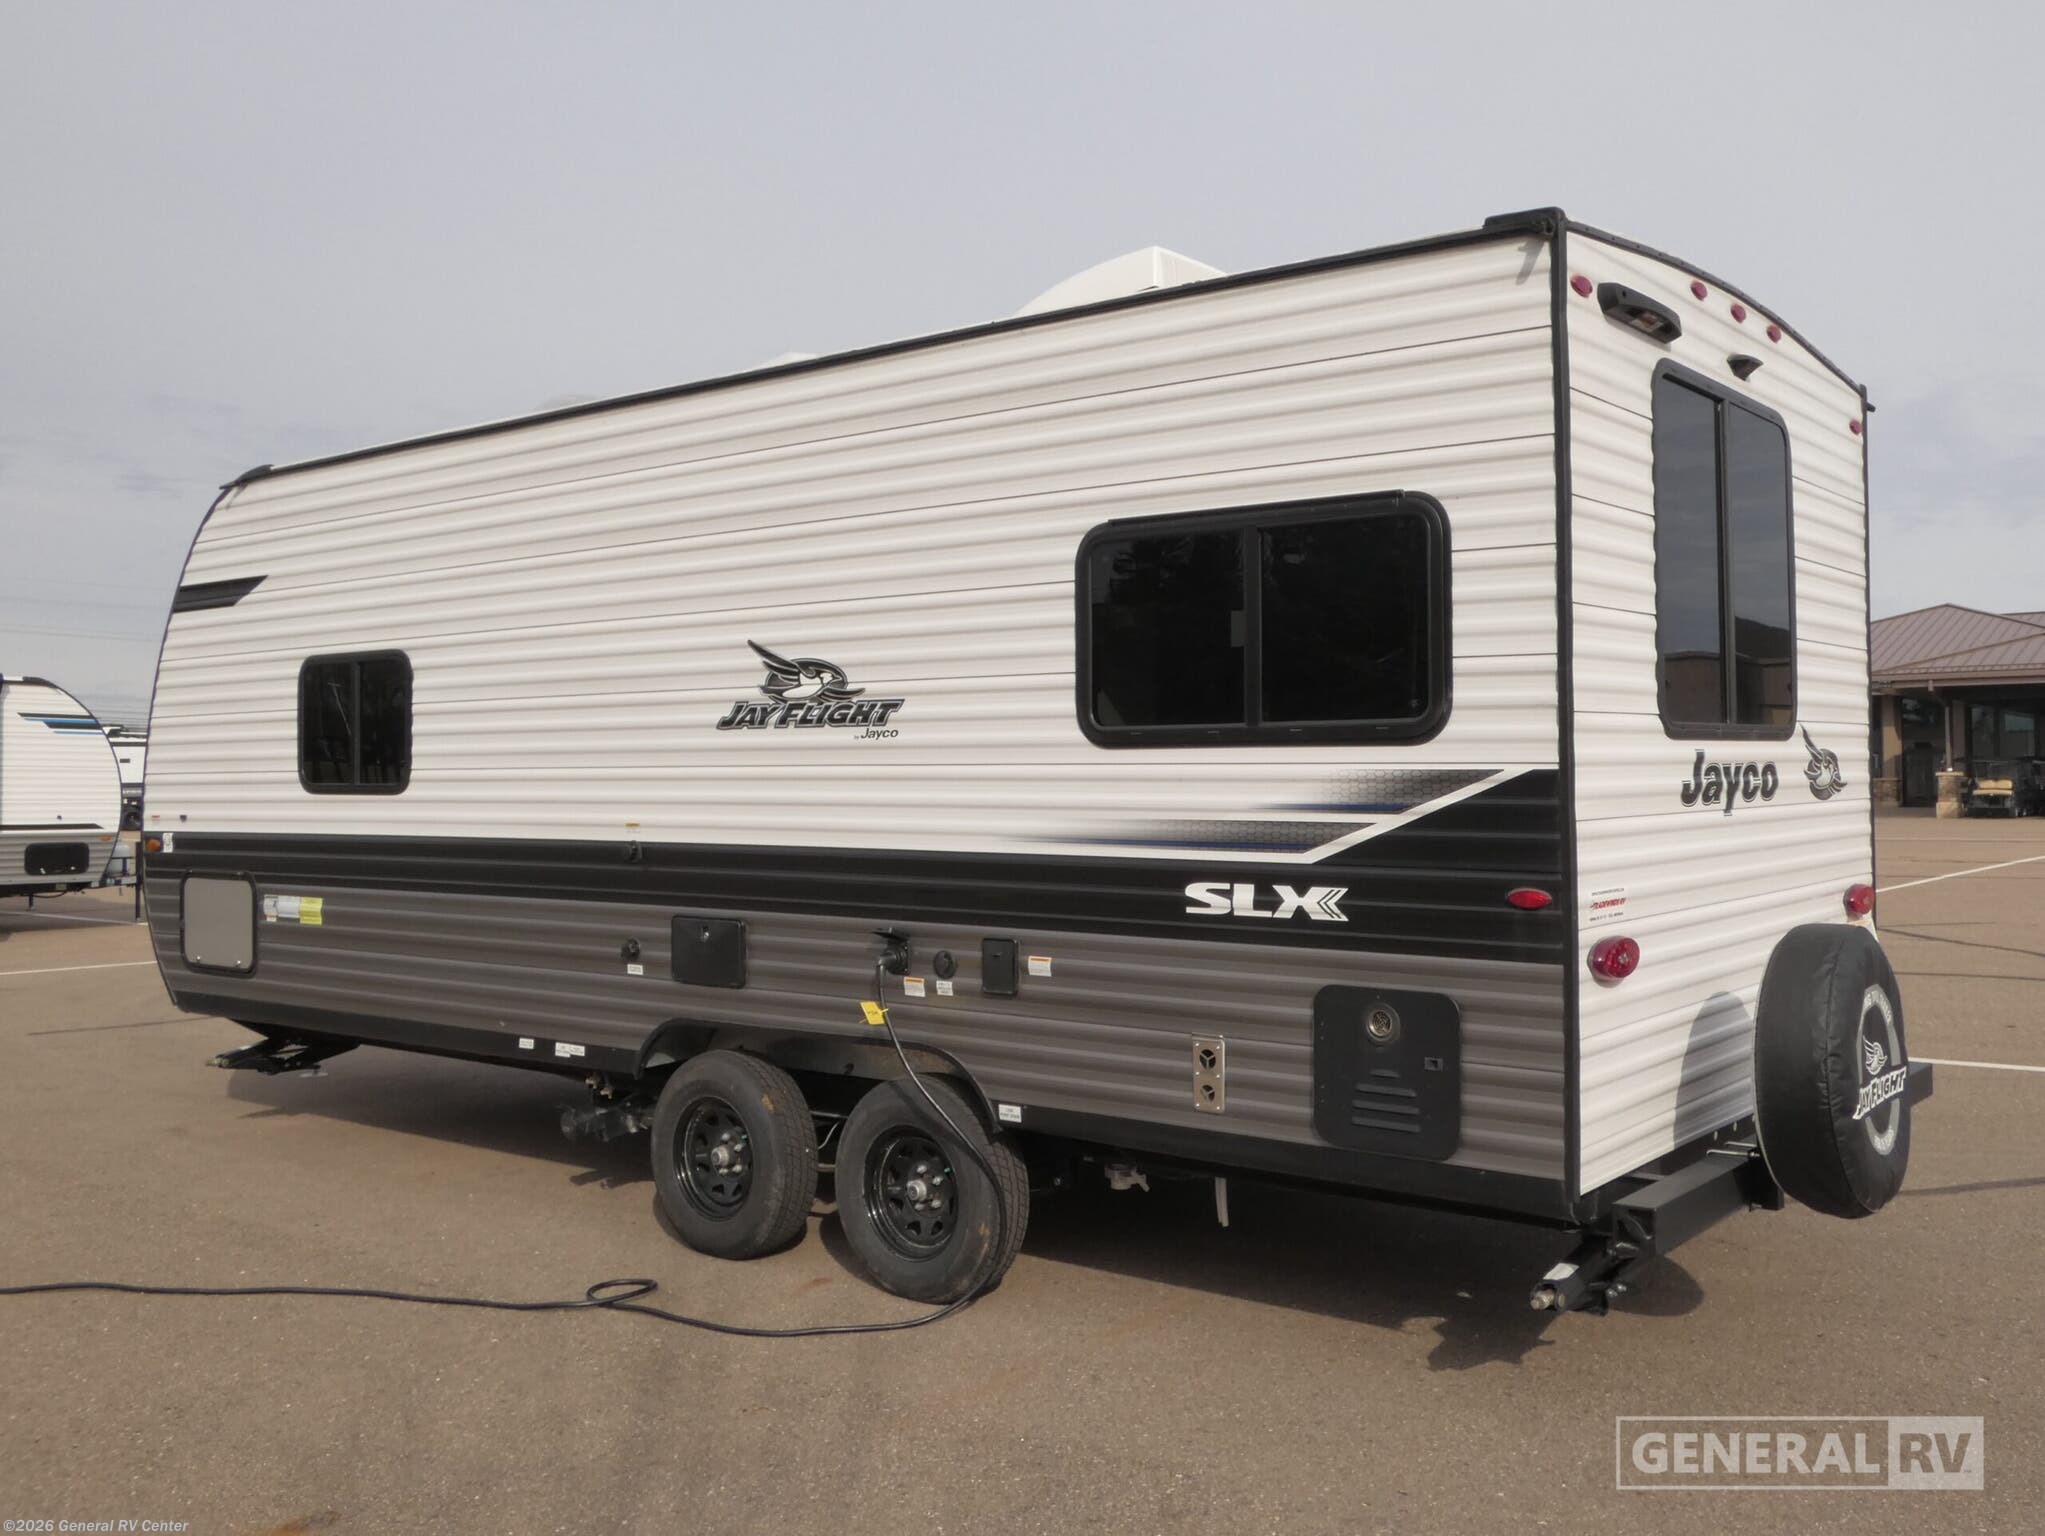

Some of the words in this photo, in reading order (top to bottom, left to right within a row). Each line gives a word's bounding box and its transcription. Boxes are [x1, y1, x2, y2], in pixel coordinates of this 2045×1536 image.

[716, 701, 784, 730] JAY
[774, 699, 905, 729] FLIGHT
[860, 728, 899, 740] Jayco
[1681, 749, 1779, 816] Jayco
[1185, 882, 1350, 922] SLX
[1870, 1066, 1907, 1109] FLIGHT
